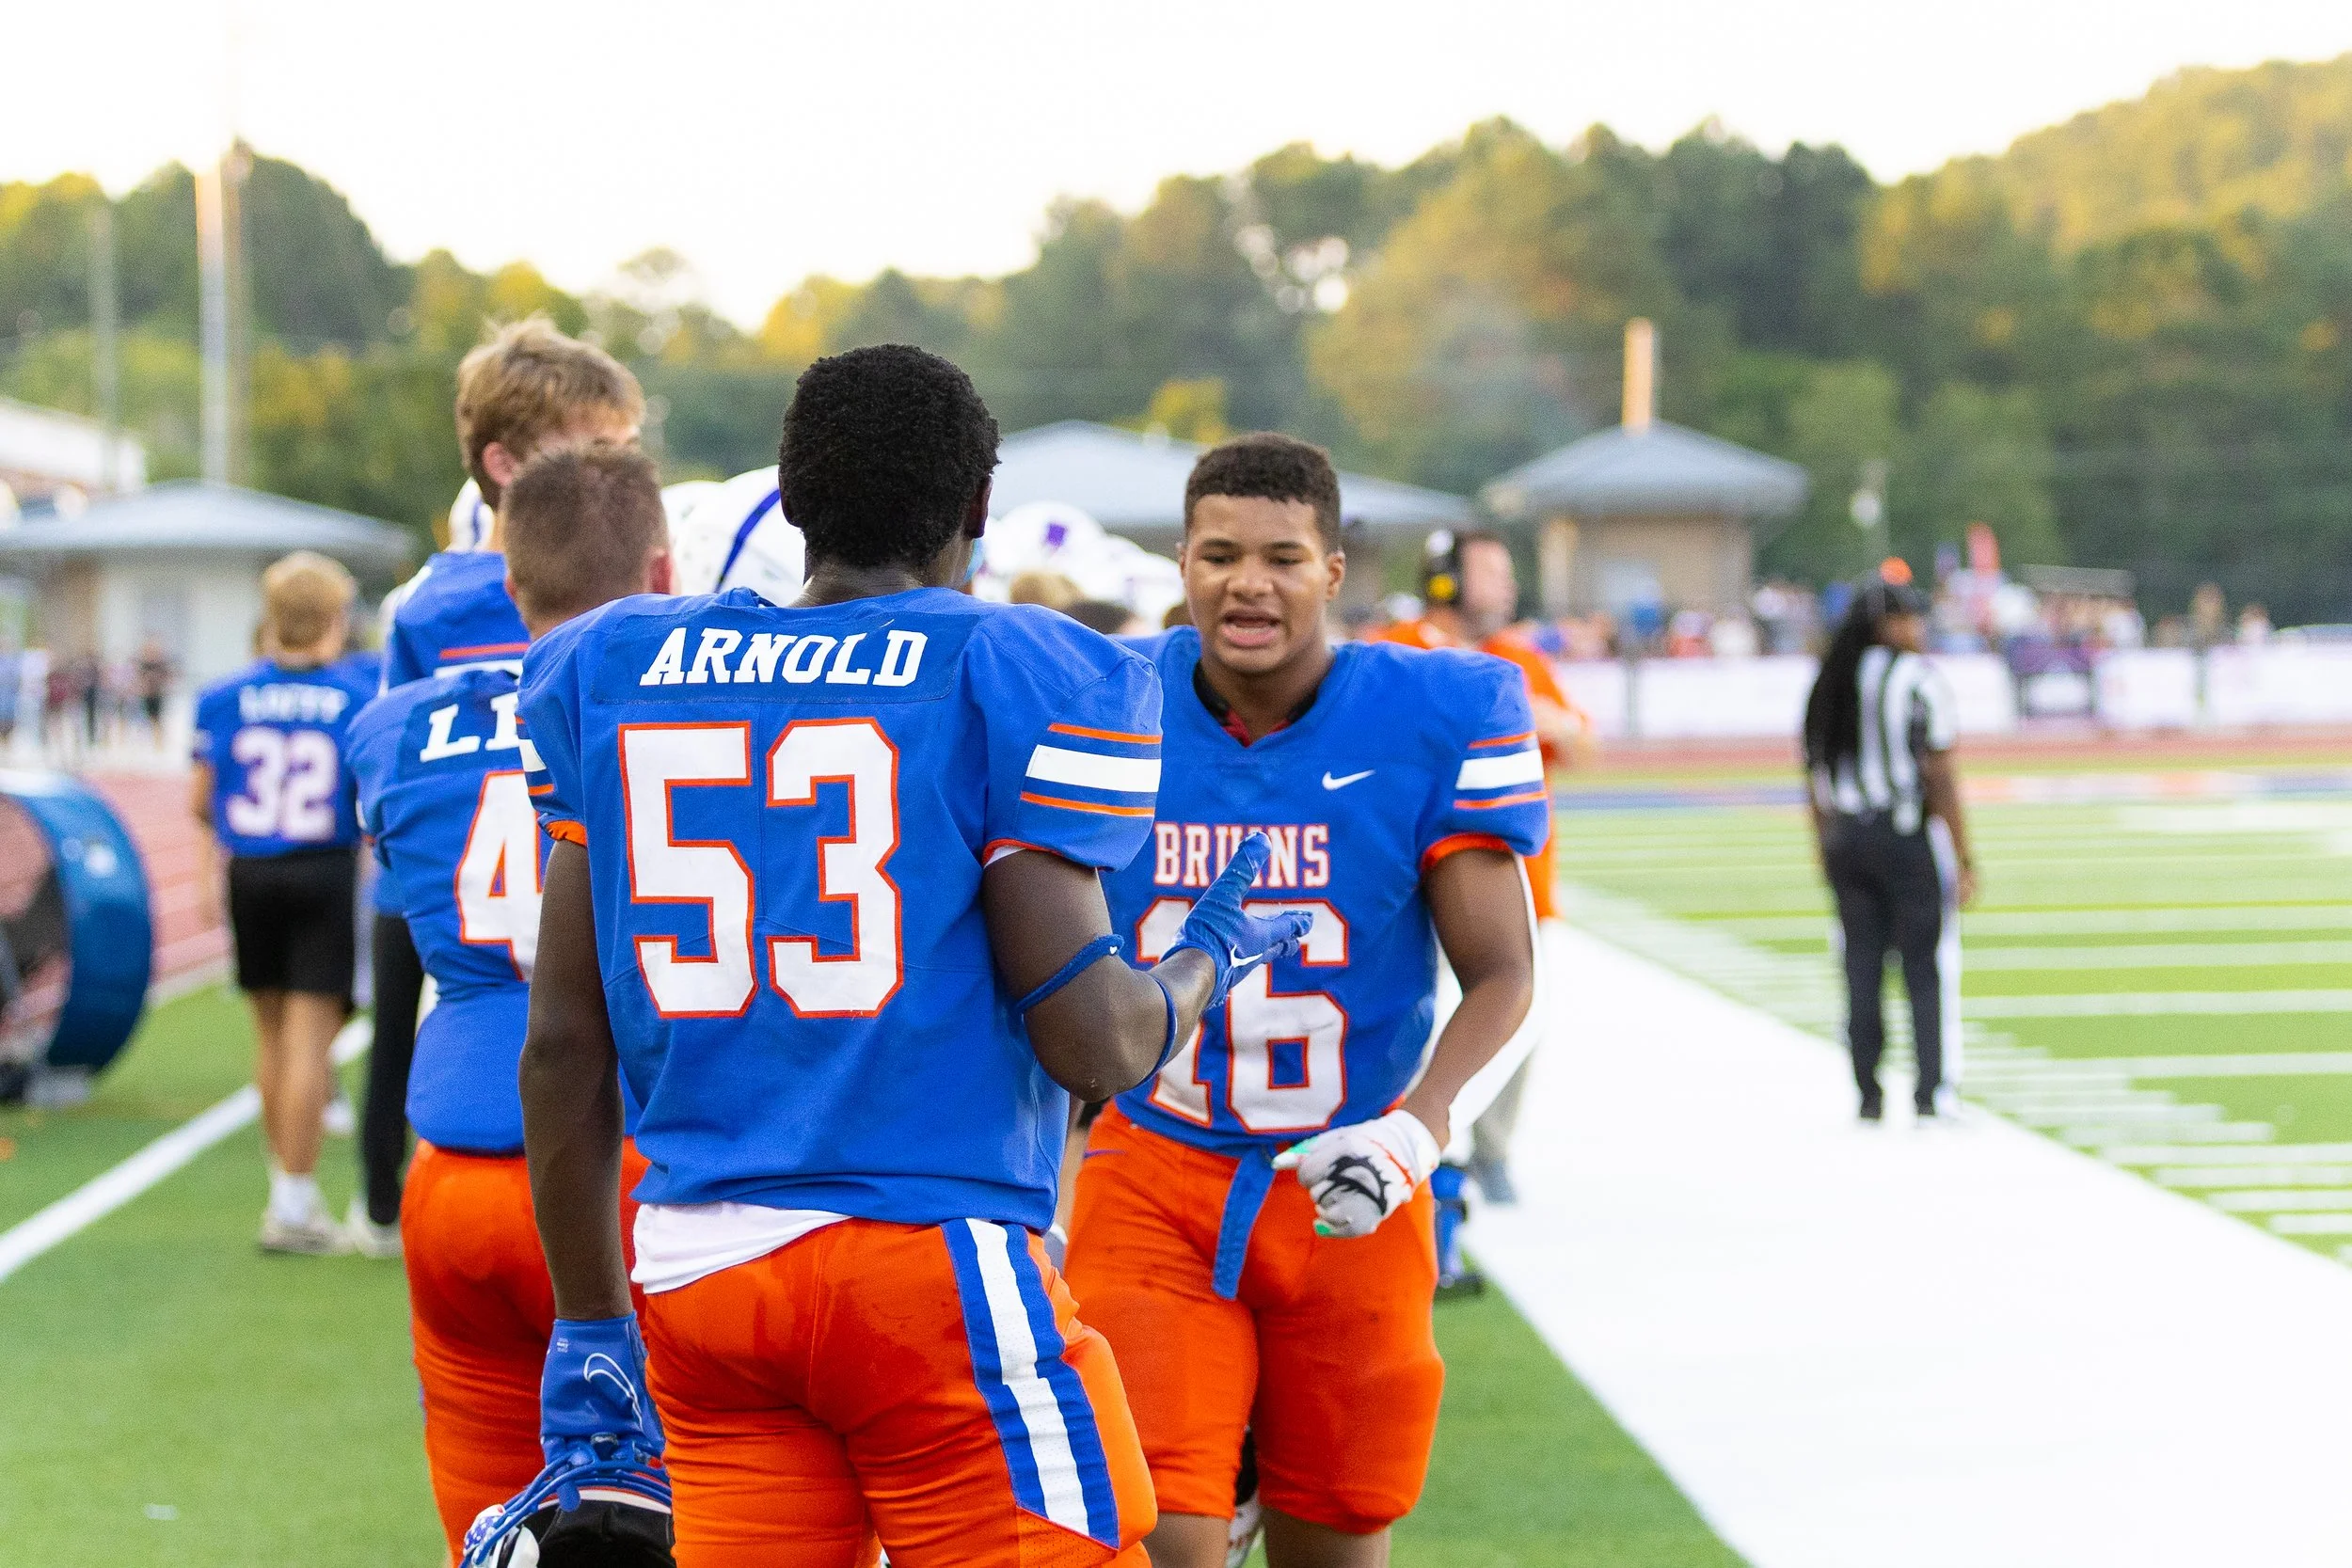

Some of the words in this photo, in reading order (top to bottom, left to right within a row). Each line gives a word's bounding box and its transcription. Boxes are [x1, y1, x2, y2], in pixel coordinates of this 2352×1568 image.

[640, 627, 928, 687] ARNOLD
[226, 725, 339, 842] 32
[618, 717, 903, 1019] 53
[1153, 821, 1331, 889] BRUNS
